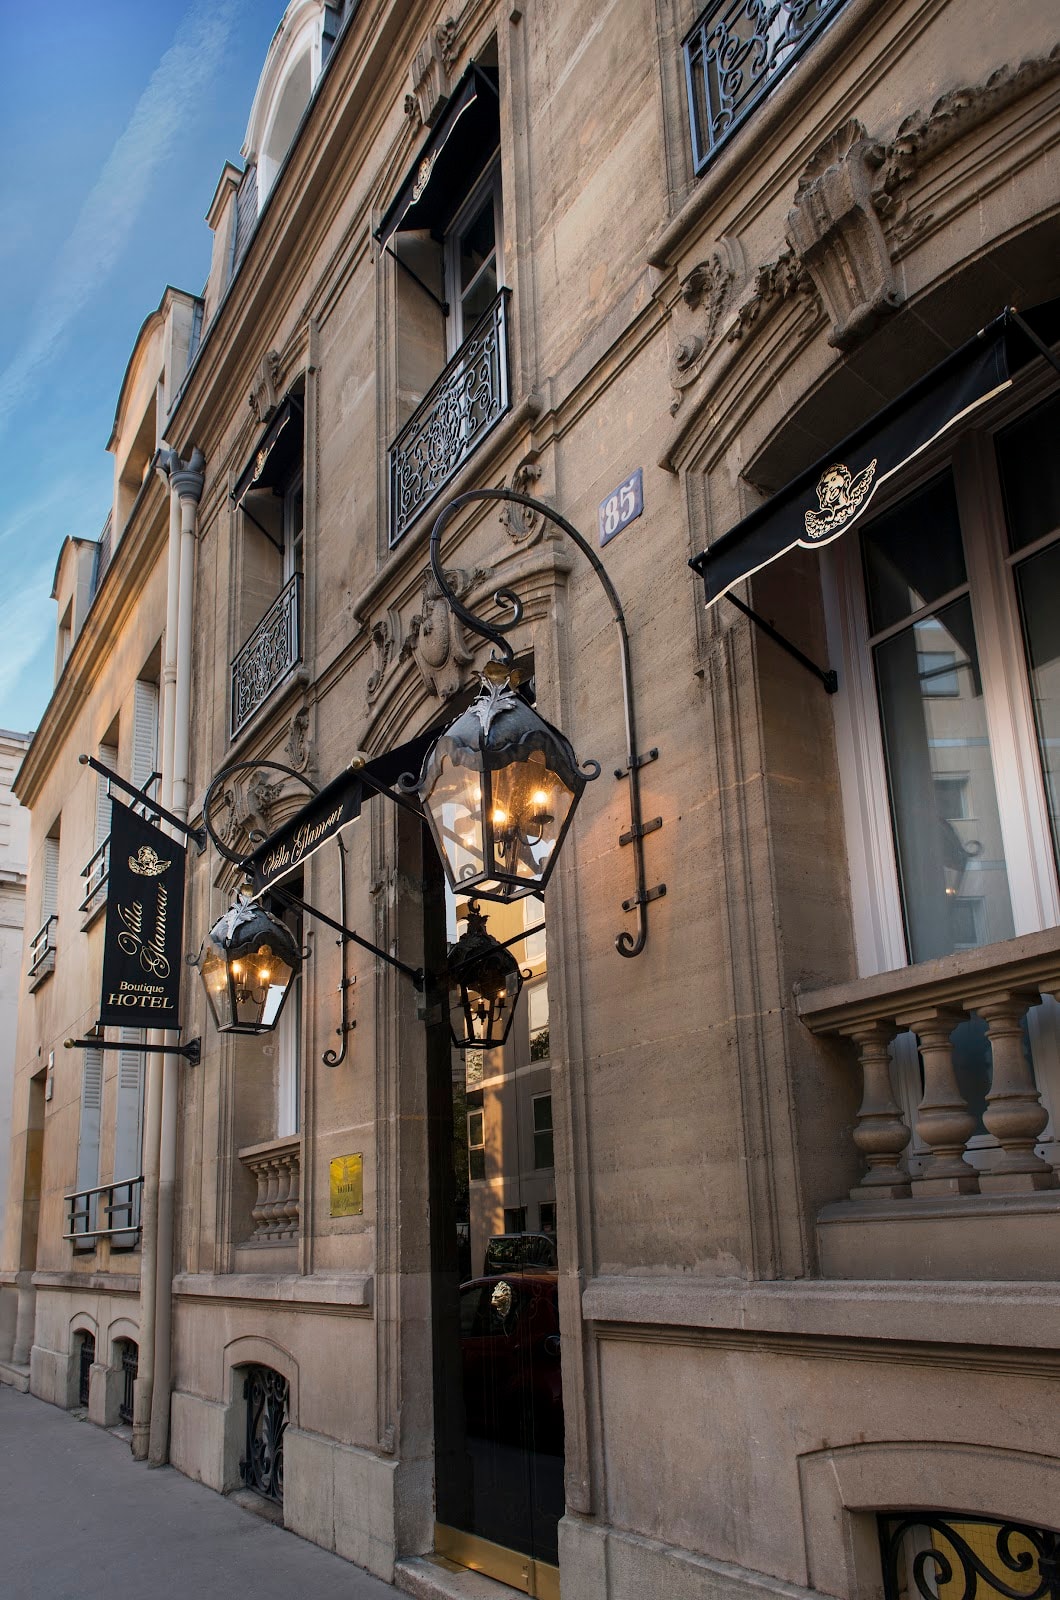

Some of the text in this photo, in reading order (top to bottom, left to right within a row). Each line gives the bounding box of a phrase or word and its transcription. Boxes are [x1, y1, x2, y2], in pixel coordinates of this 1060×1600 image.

[605, 478, 635, 534] 85
[262, 804, 343, 878] Villa Glamour
[117, 900, 143, 955] Villa
[139, 882, 171, 979] Glamour
[106, 993, 175, 1009] HOTEL
[119, 981, 165, 995] Boutique
